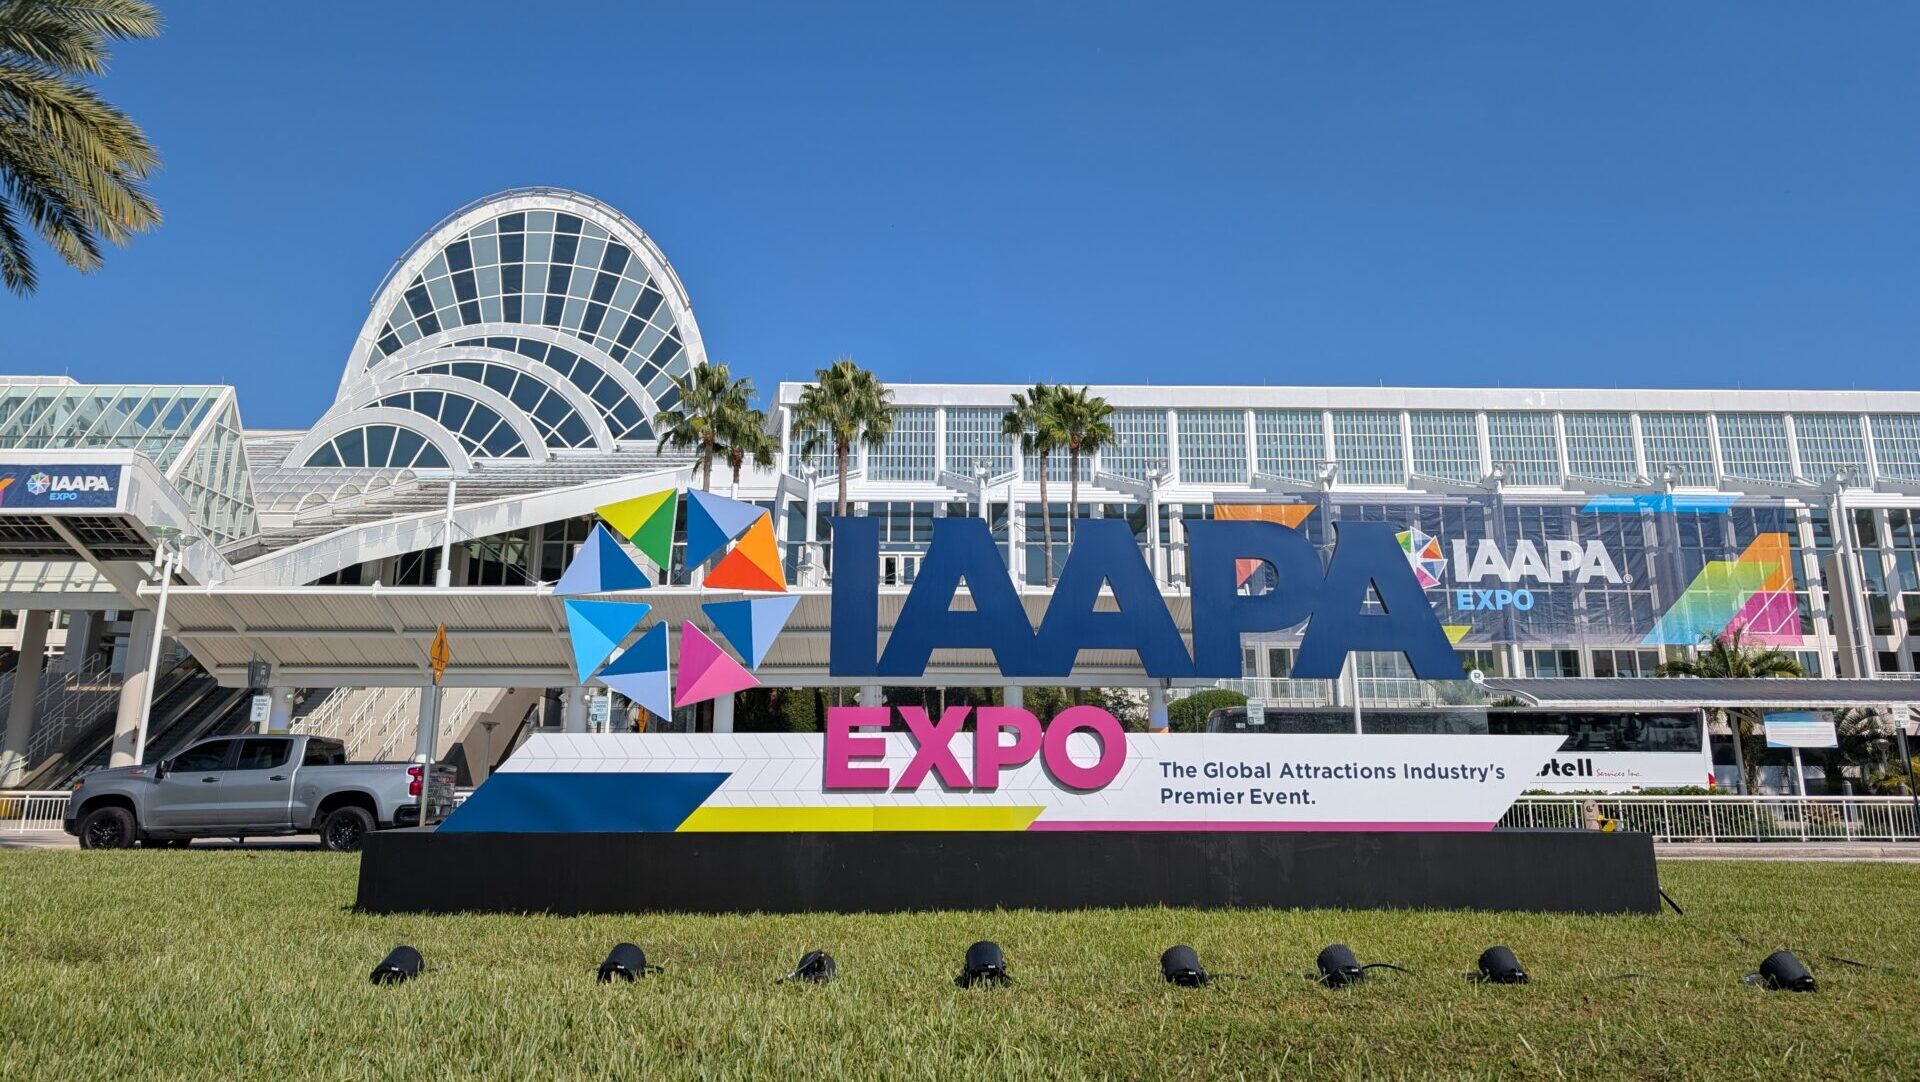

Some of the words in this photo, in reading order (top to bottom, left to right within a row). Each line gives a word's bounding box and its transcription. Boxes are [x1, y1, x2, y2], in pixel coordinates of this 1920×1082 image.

[49, 492, 78, 501] EXPO
[1456, 588, 1535, 612] EXPO
[823, 705, 1128, 793] EXPO
[1159, 761, 1198, 779] The
[1203, 761, 1271, 779] Global
[1279, 762, 1397, 780] Attractions
[1403, 762, 1506, 783] Industry's
[1536, 758, 1593, 777] stell
[1596, 768, 1625, 777] Services
[1160, 787, 1245, 805] Premier
[1250, 787, 1317, 806] Event.
